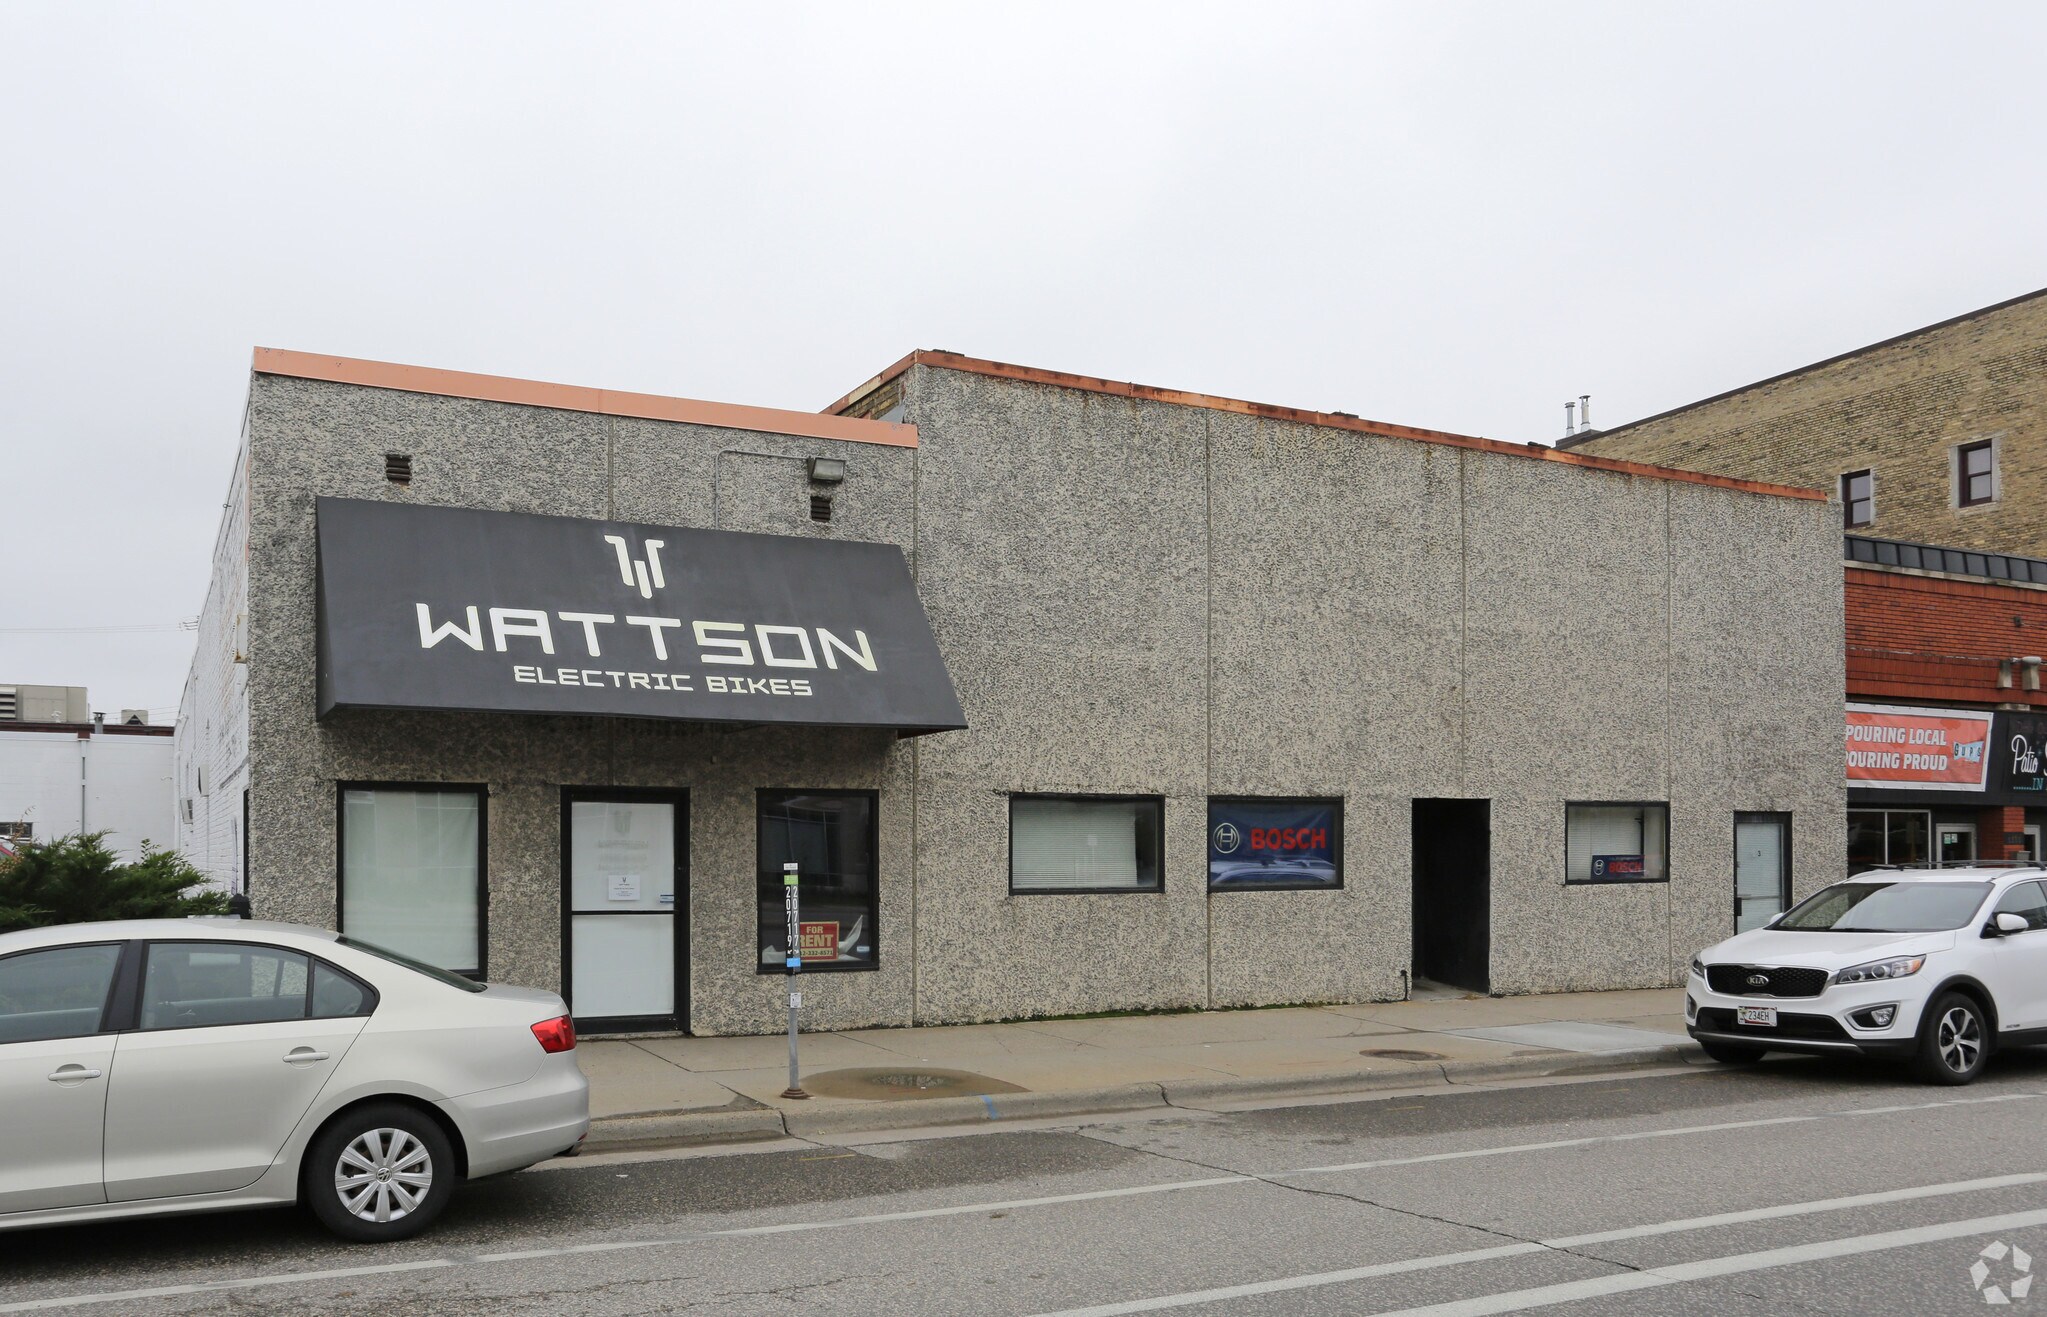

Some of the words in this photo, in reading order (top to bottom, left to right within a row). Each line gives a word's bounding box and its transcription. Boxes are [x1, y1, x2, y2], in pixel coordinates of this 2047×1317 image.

[415, 603, 878, 672] WATTSON
[513, 665, 694, 692] ELECTRIC
[706, 675, 814, 697] BIKES
[1846, 724, 1906, 745] POURING
[1908, 728, 1947, 746] LOCAL
[1903, 753, 1948, 771] PROUD
[2011, 734, 2039, 775] Patio
[1251, 828, 1326, 850] BOSCH
[1608, 861, 1642, 873] BOSCH
[806, 925, 824, 934] FOR
[1749, 977, 1765, 985] KIA
